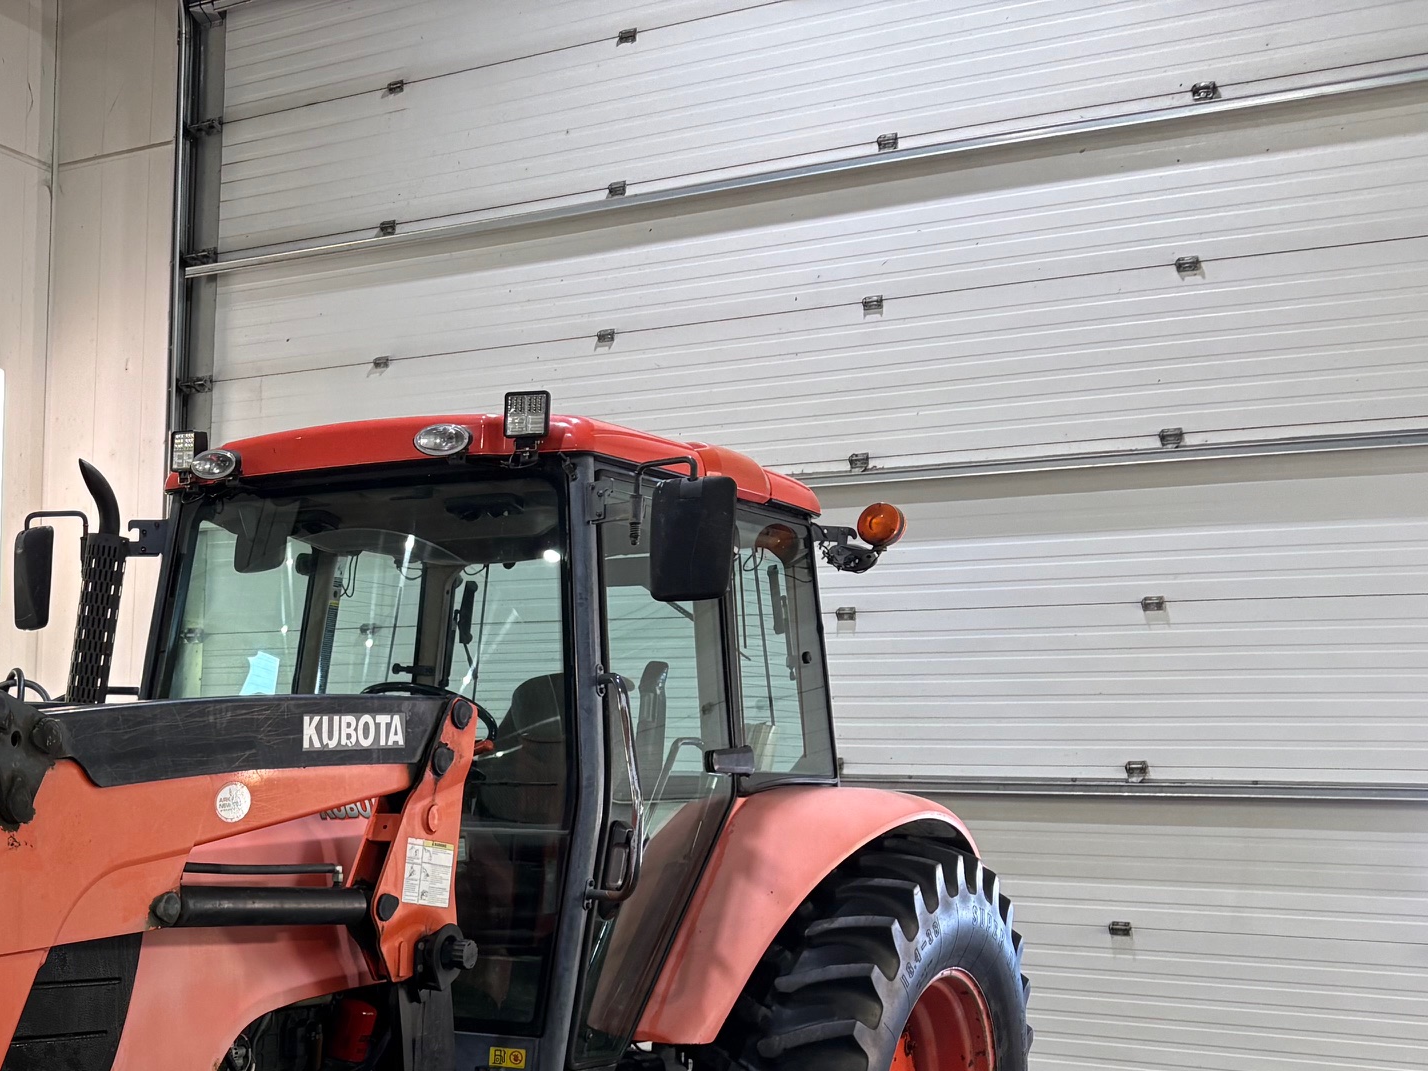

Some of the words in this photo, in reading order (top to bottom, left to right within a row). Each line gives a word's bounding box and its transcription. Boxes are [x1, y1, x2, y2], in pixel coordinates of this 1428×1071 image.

[303, 714, 405, 749] KUBOTA
[972, 905, 1006, 949] SUPER
[900, 919, 942, 988] 18.4-38
